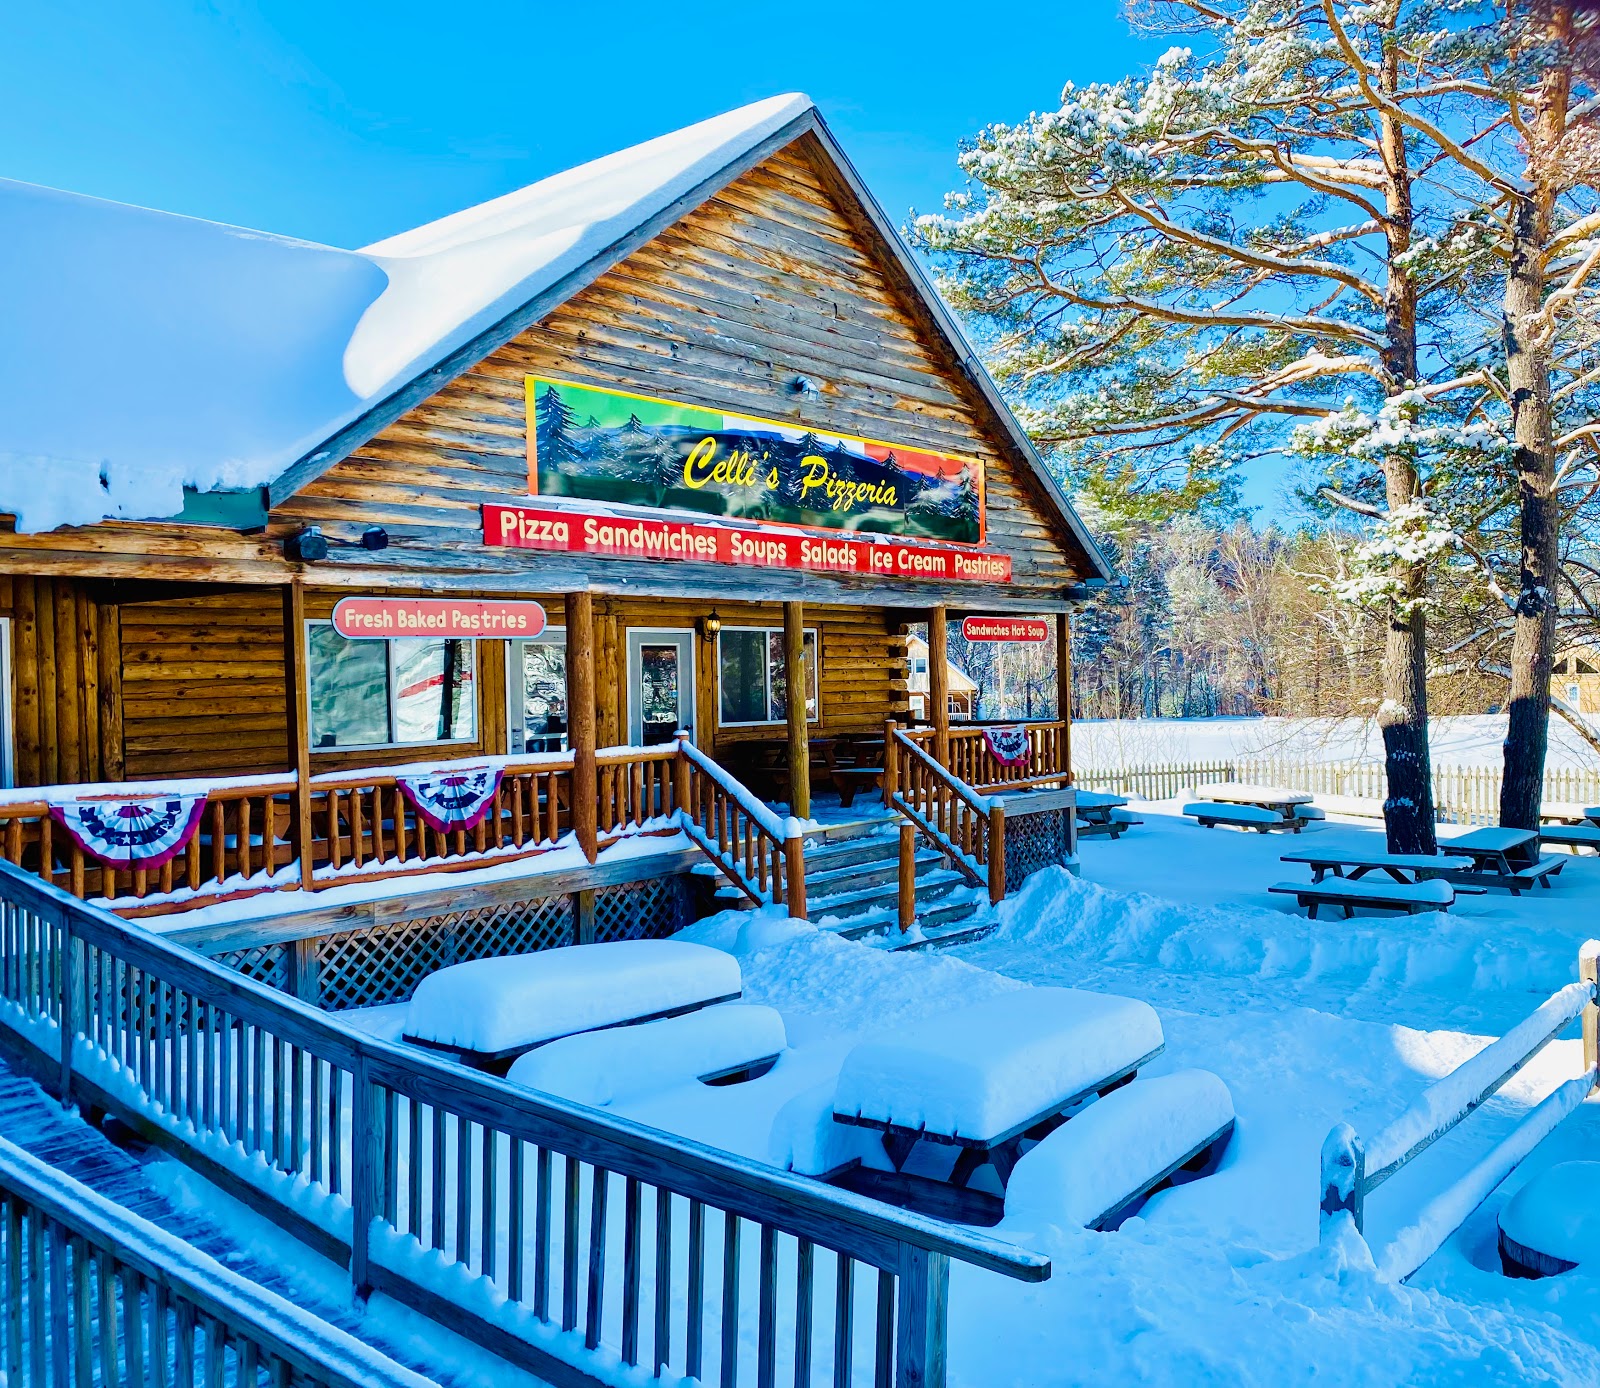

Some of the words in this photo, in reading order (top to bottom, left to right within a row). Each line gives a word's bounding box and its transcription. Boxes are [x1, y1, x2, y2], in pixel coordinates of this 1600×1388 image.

[683, 436, 779, 489] Celli's
[800, 455, 898, 512] Pizzeria
[500, 510, 569, 542] Pizza
[584, 518, 717, 554] Sandwiches
[730, 532, 787, 565] Soups
[800, 539, 857, 566] Salads
[869, 546, 893, 568] Ice
[898, 549, 946, 571] Cream
[954, 554, 1005, 576] Pastries
[344, 608, 393, 628] Fresh
[397, 609, 447, 629] Baked
[452, 609, 527, 629] Pastries
[966, 623, 1010, 636] Sandwiches
[1011, 624, 1026, 636] Hot
[1027, 625, 1045, 639] Soup
